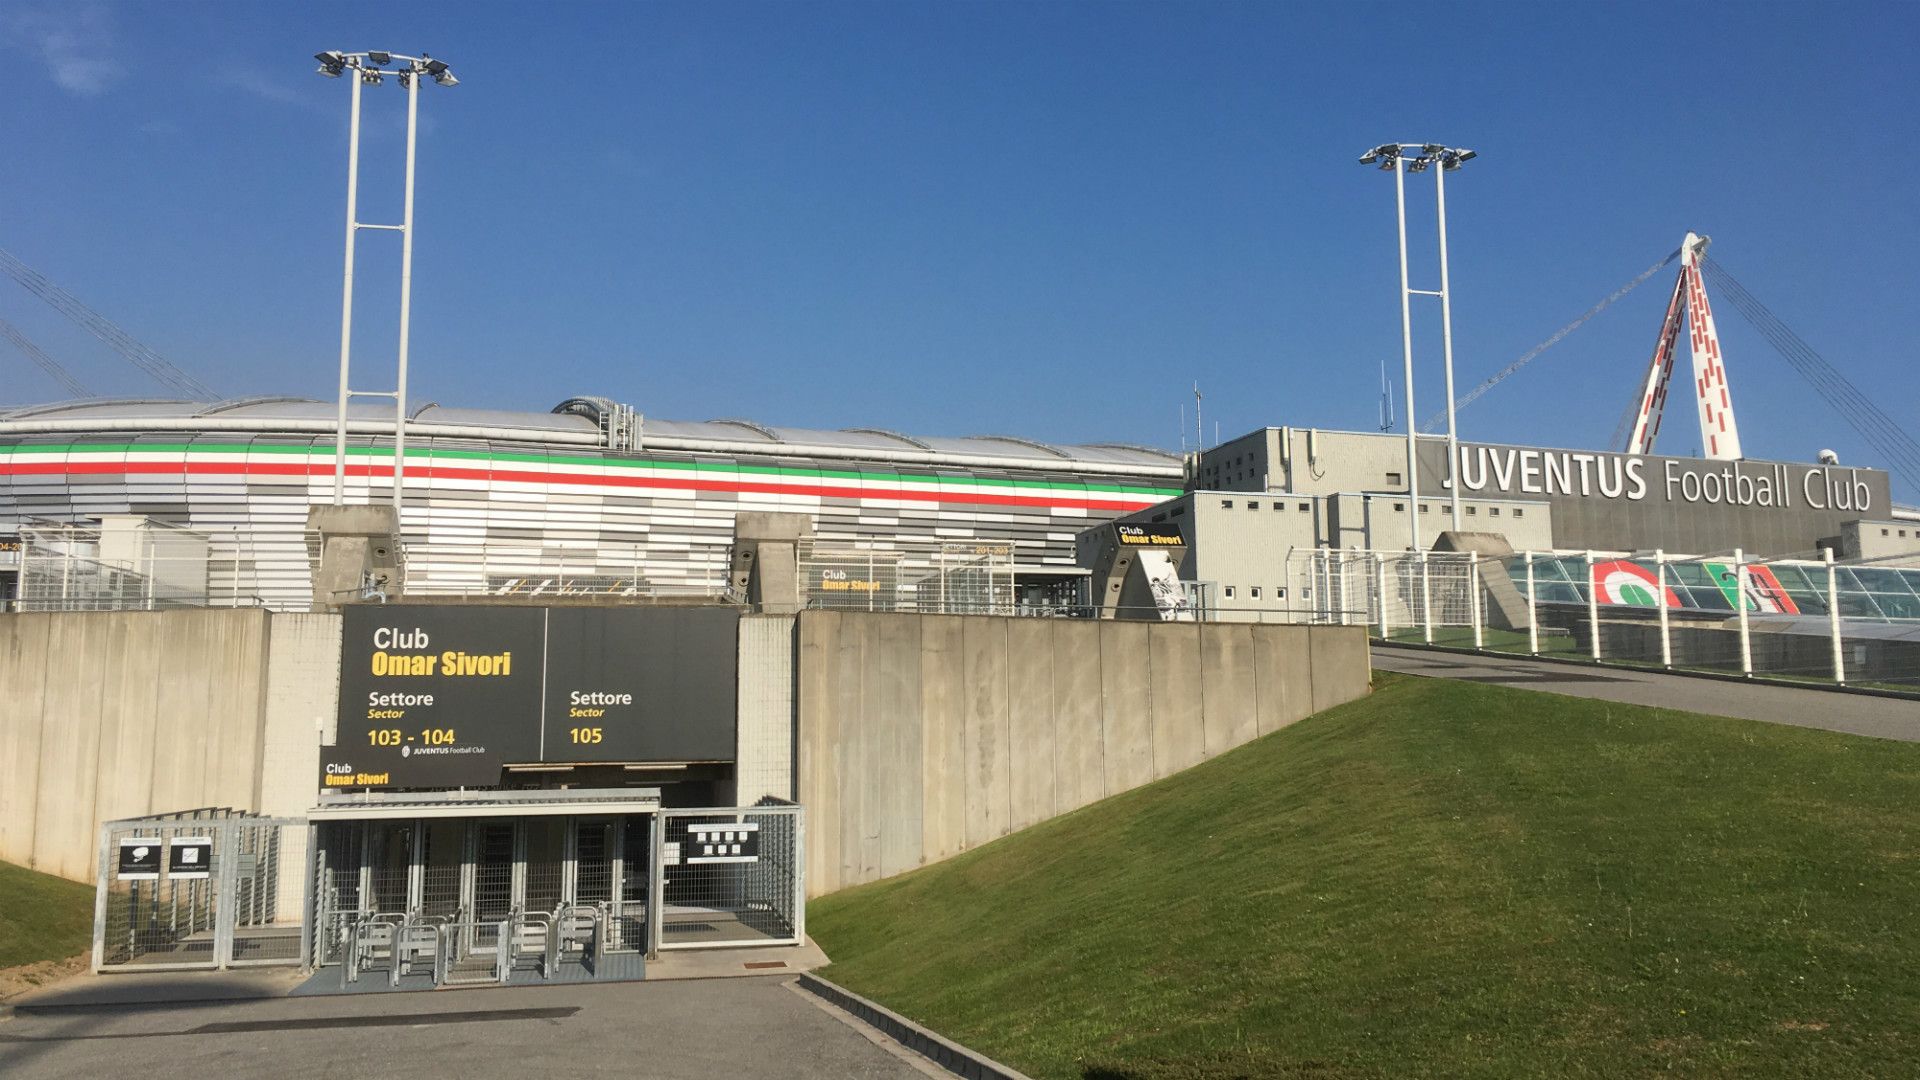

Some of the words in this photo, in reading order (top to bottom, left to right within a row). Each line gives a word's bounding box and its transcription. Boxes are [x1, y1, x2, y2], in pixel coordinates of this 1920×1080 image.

[1664, 459, 1790, 507] Football
[1803, 467, 1871, 511] Club
[1119, 526, 1144, 535] Club
[1121, 534, 1149, 544] Omar
[1150, 535, 1182, 545] Sivori
[822, 569, 847, 580] Club
[373, 627, 430, 650] Club
[371, 651, 438, 676] Omar
[441, 651, 511, 676] Sivori
[368, 691, 434, 707] Settore
[570, 690, 633, 706] Settore
[367, 708, 405, 719] Sector
[569, 707, 606, 718] Sector
[367, 729, 402, 746] 103
[421, 728, 456, 745] 104
[570, 727, 603, 744] 105
[413, 747, 449, 755] JUVENTUS
[449, 746, 472, 754] Football
[472, 746, 486, 754] Club
[326, 763, 352, 774] Club
[325, 774, 356, 786] Omar
[356, 772, 389, 785] Sivori
